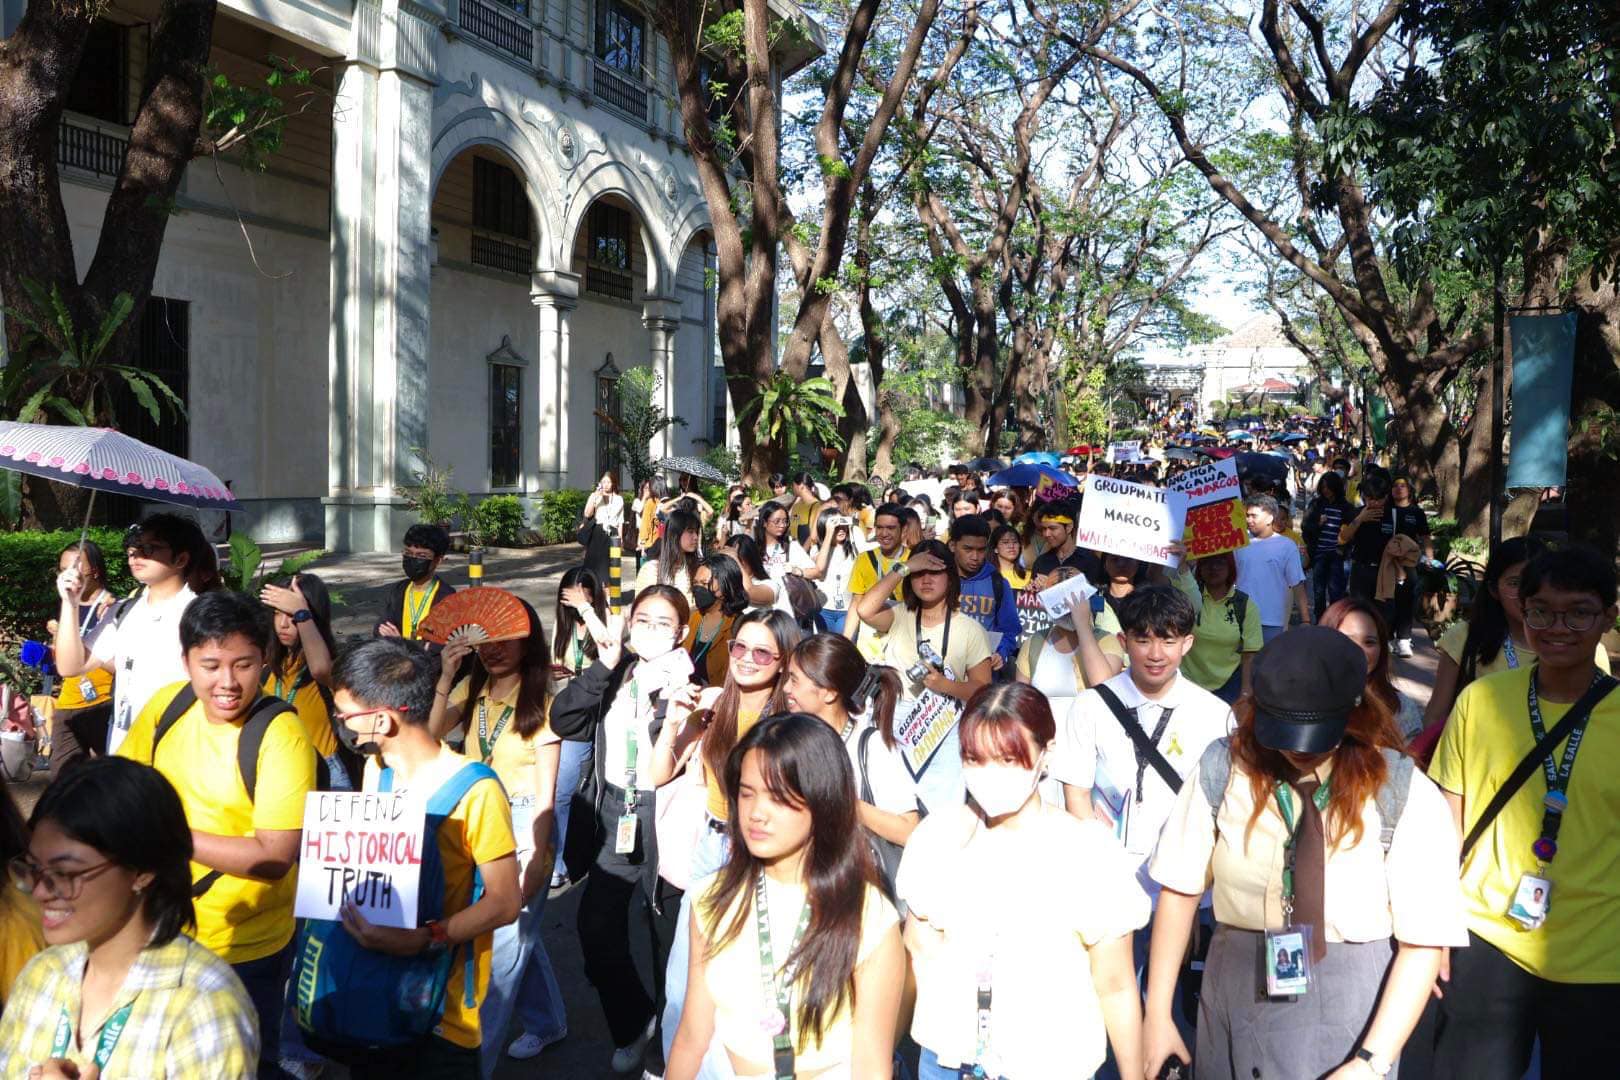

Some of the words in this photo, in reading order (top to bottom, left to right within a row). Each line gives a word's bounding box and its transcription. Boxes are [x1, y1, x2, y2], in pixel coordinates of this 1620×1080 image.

[1094, 479, 1168, 504] GROUPMATE
[1172, 471, 1228, 492] AGAWA
[1104, 507, 1161, 532] MARCOS
[1565, 728, 1583, 761] SALLE
[1545, 754, 1557, 781] SALL
[1560, 763, 1571, 778] LA
[319, 793, 405, 822] DEFEND
[305, 830, 424, 865] HISTORICAL
[323, 867, 393, 909] TRUTH
